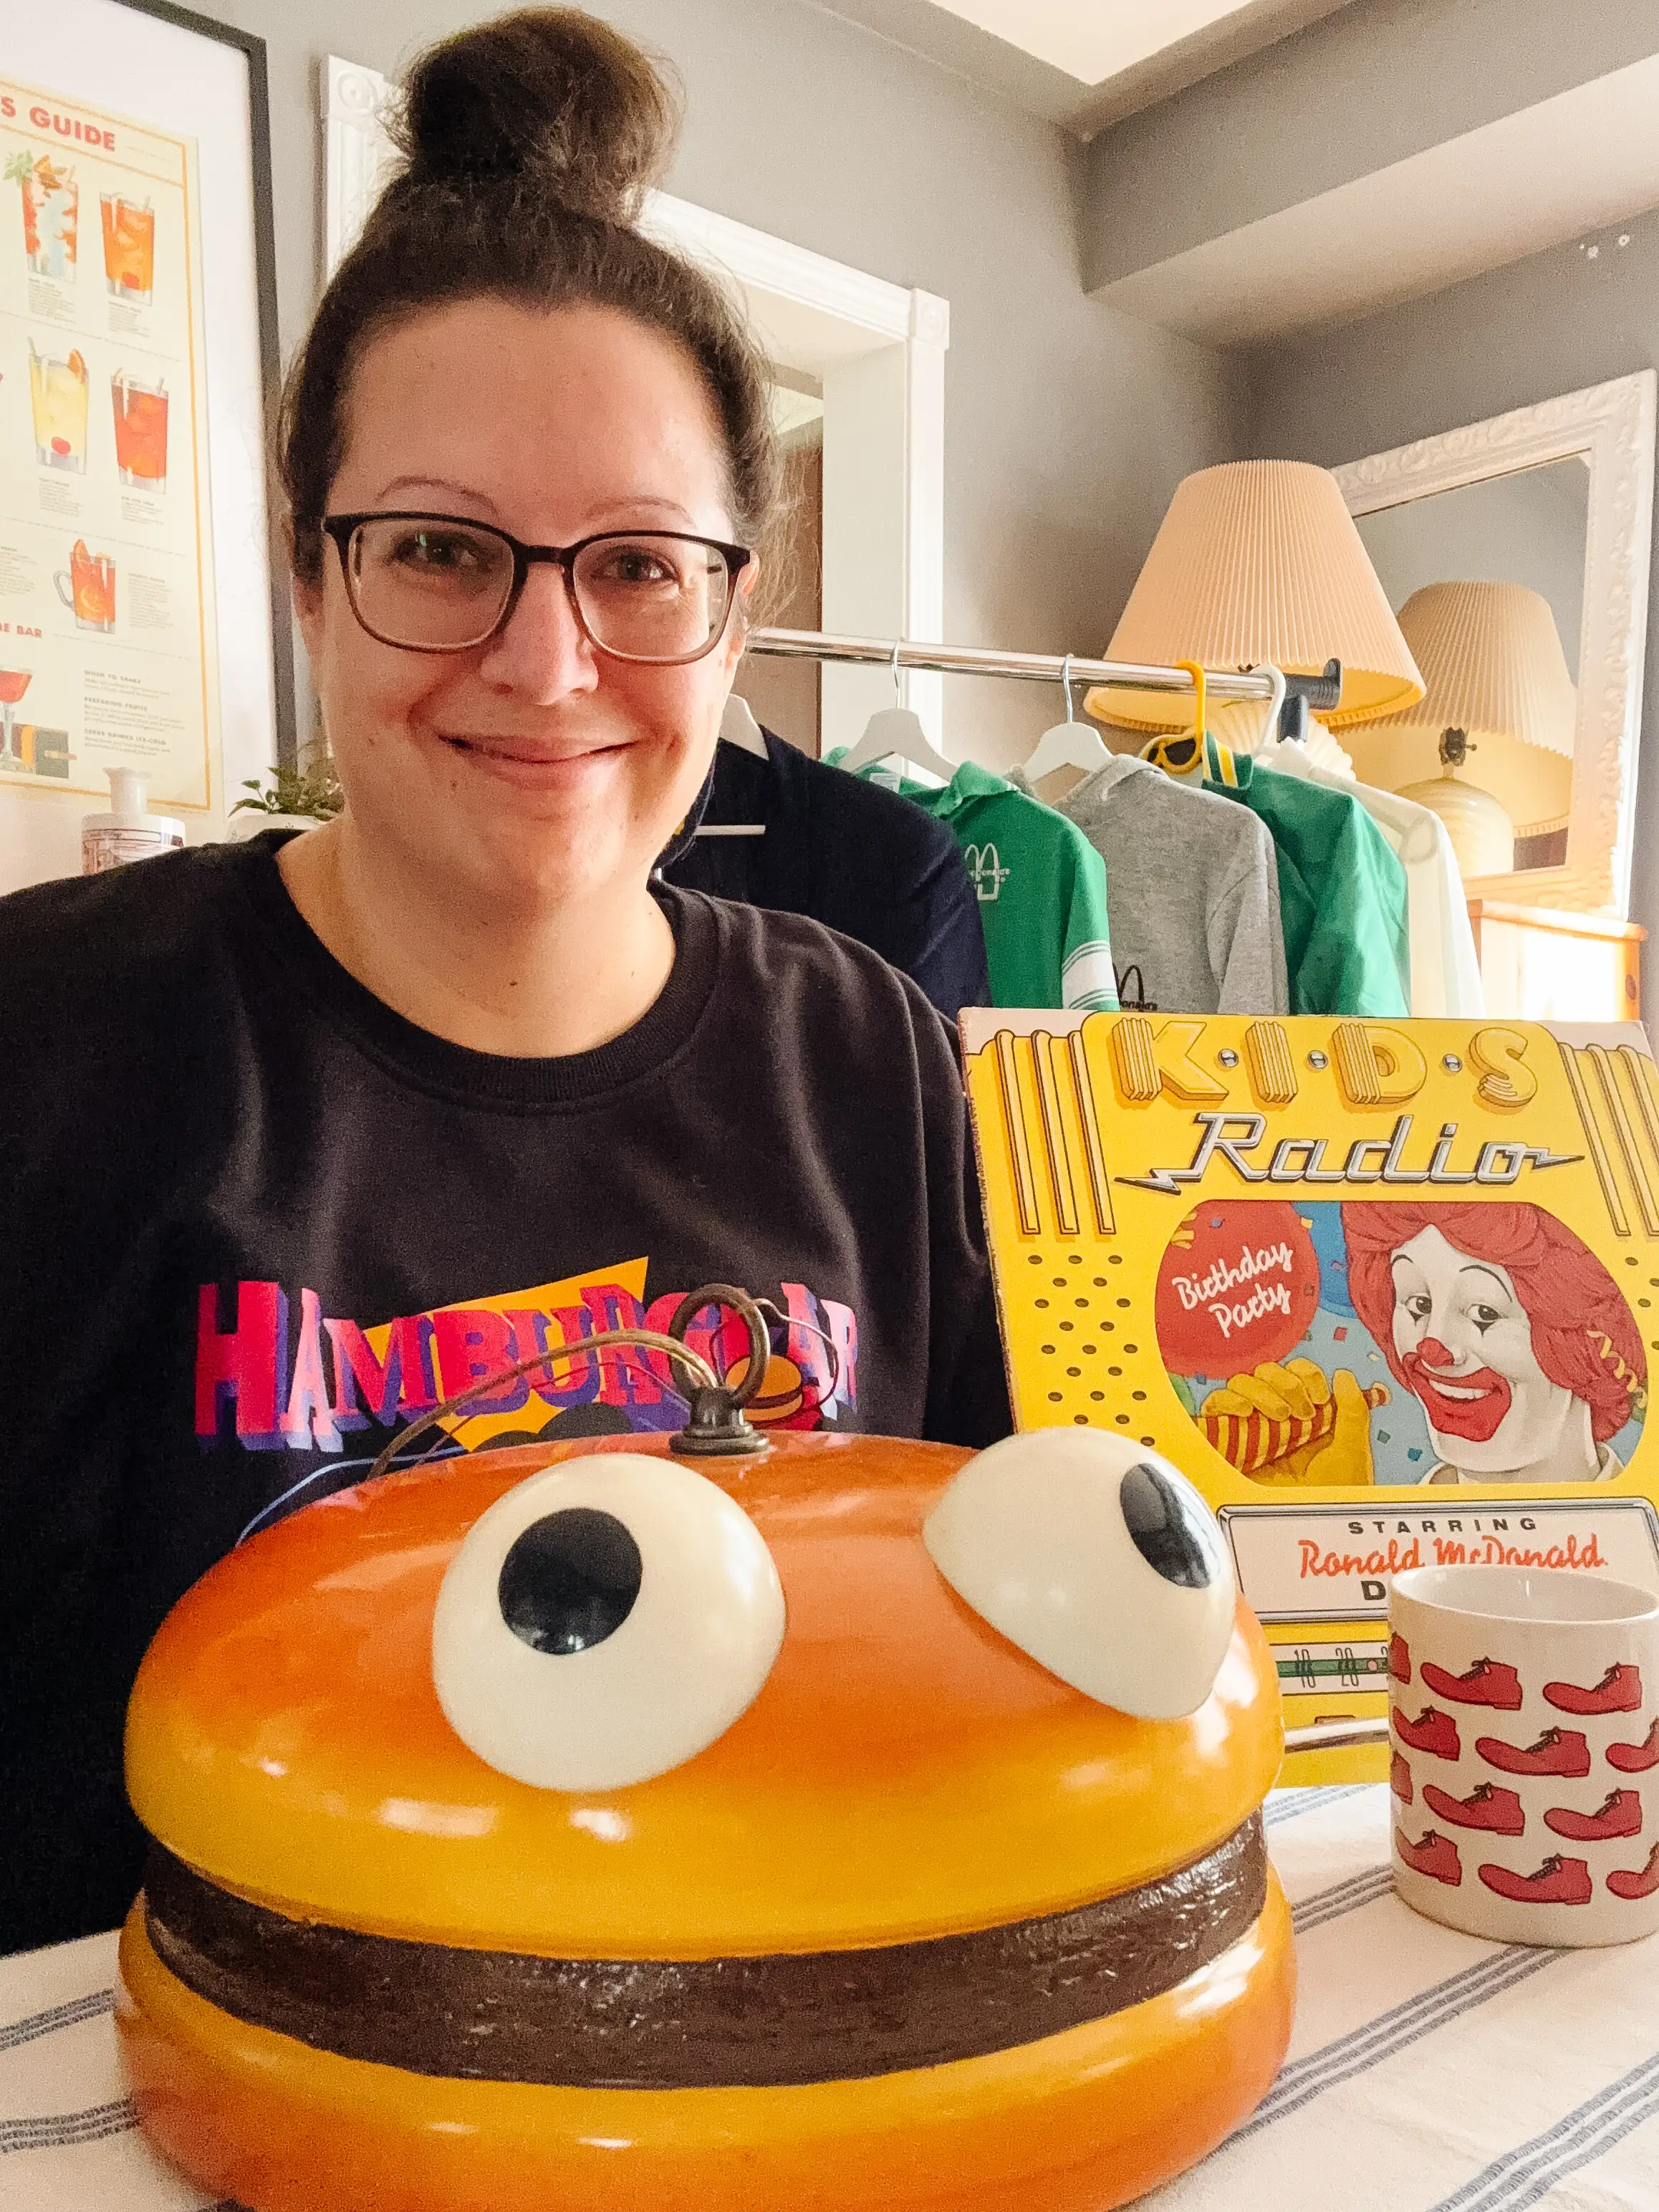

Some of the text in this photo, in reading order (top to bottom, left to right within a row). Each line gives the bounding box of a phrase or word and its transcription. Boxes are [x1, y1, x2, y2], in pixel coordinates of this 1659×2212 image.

[29, 106, 116, 152] GUIDE
[16, 625, 42, 638] BAR
[1168, 1112, 1531, 1186] Radio
[1172, 1242, 1293, 1309] Birthday
[1208, 1283, 1290, 1338] Party
[1347, 1517, 1537, 1534] STARRING
[1298, 1533, 1605, 1578] Ronald McDonald
